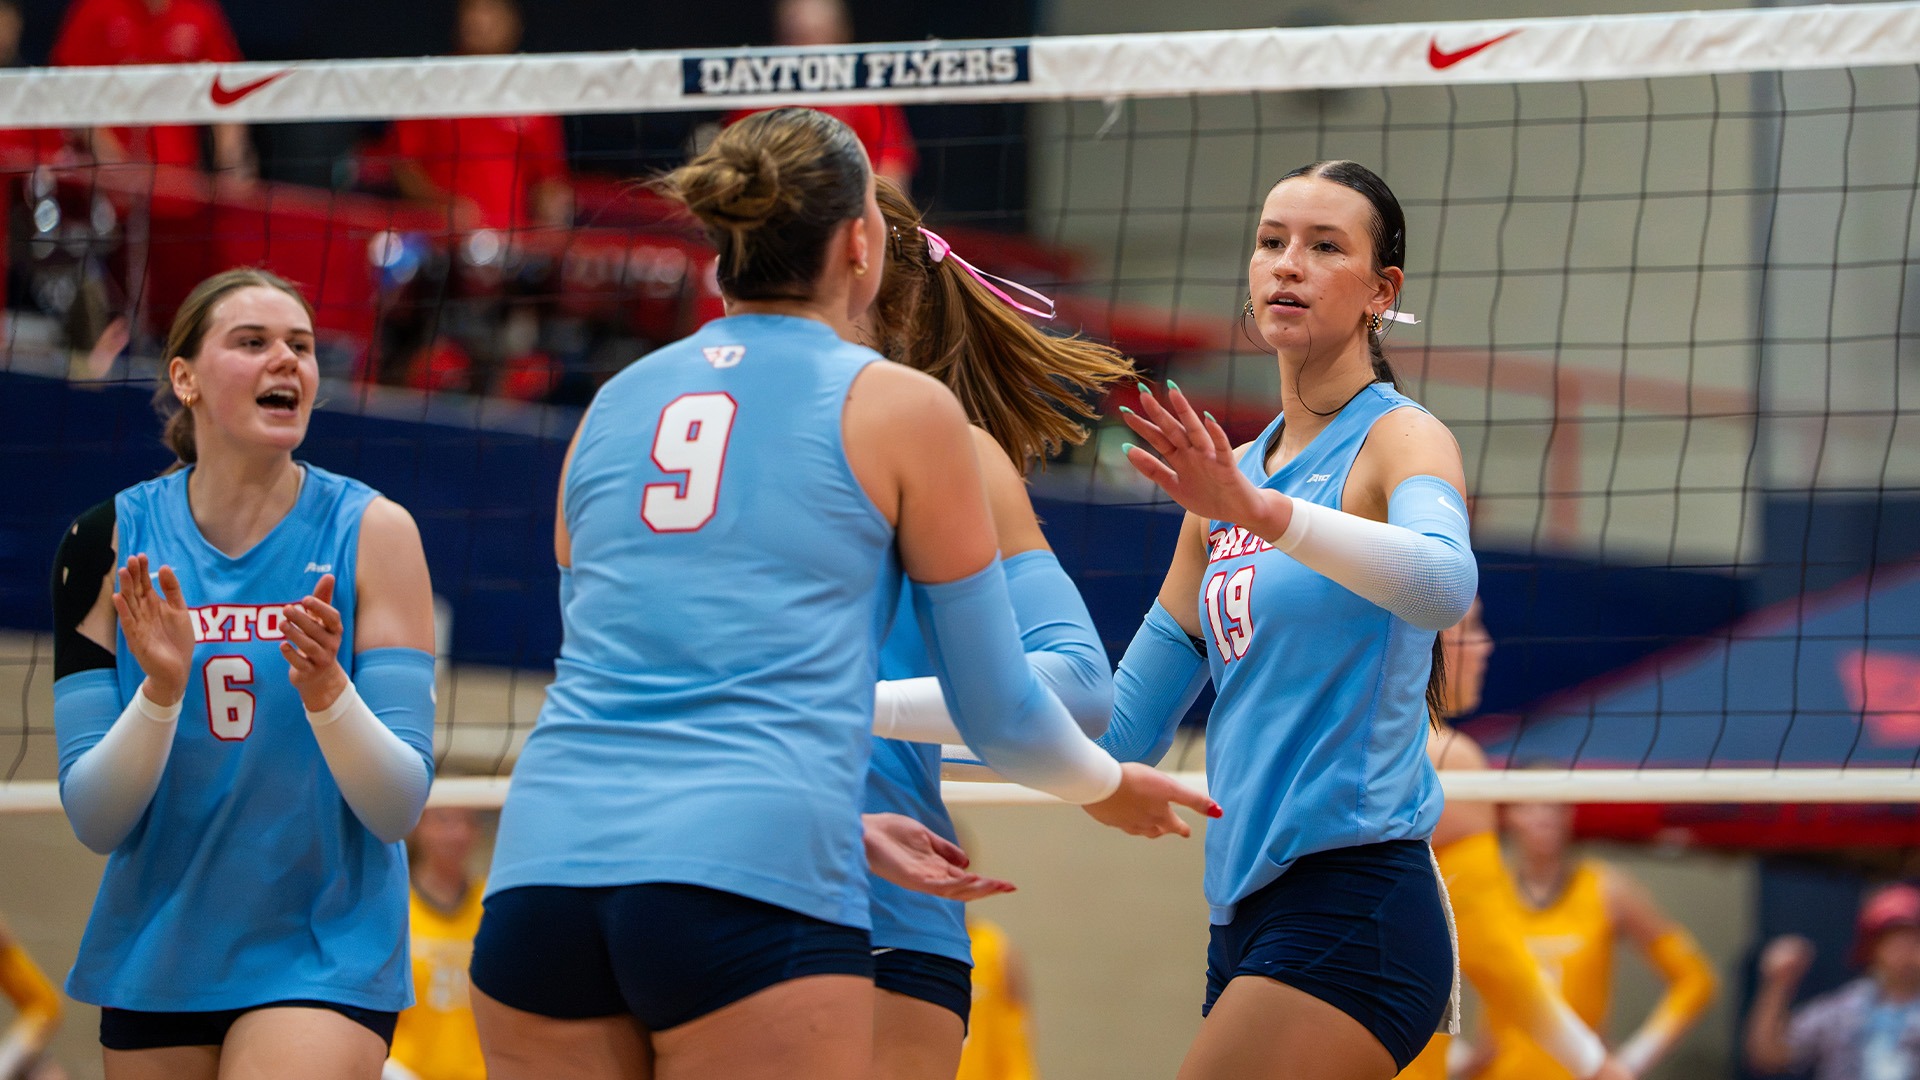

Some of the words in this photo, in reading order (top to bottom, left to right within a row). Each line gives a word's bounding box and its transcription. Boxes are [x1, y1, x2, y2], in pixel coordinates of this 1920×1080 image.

[701, 54, 858, 92] DAYTON
[865, 47, 1018, 88] FLYERS
[640, 391, 738, 534] 9
[1205, 565, 1255, 664] 19
[203, 655, 256, 741] 6
